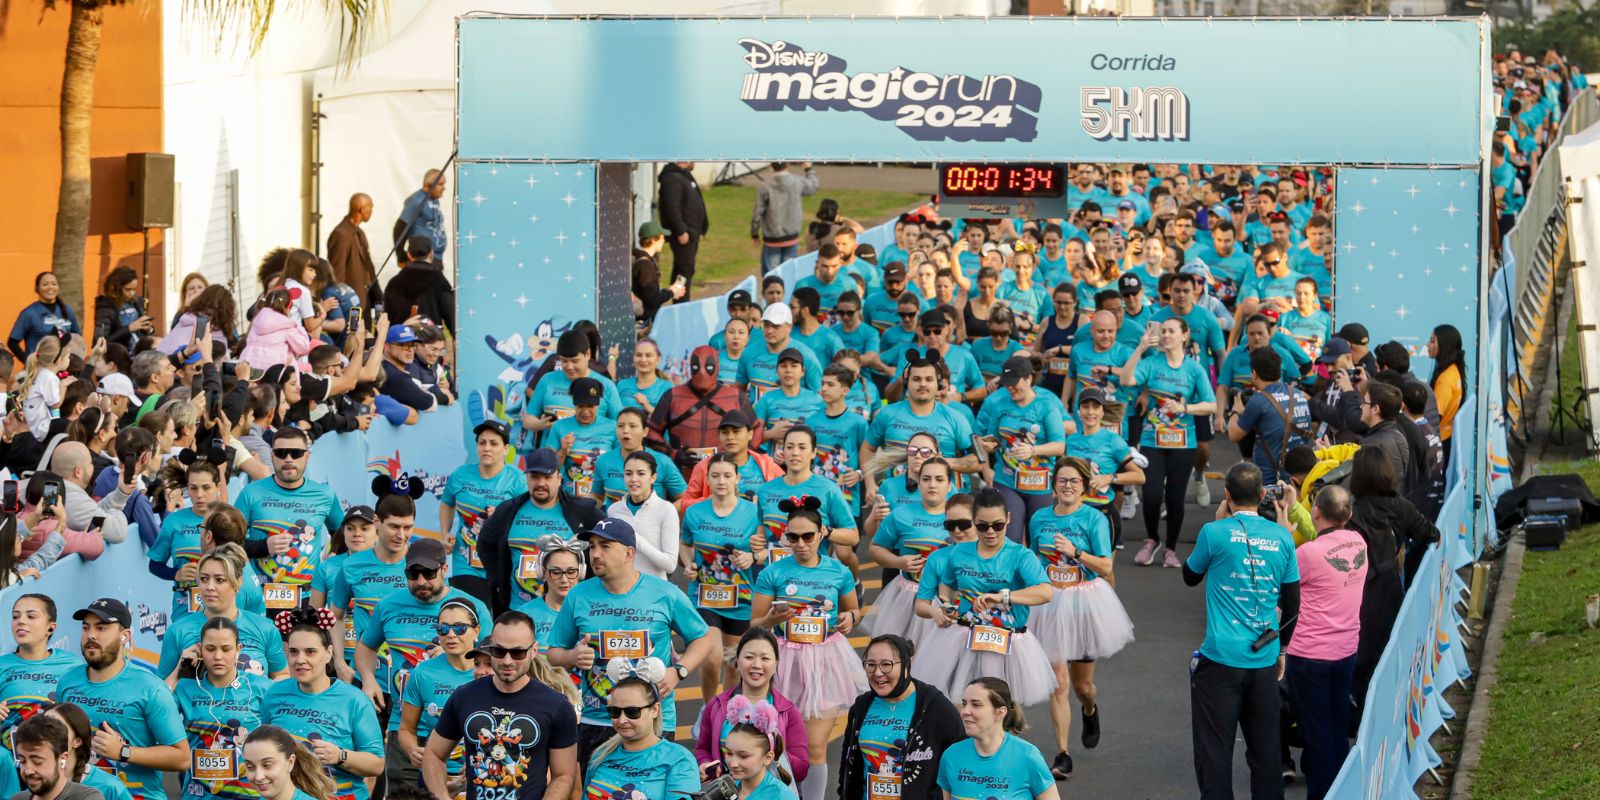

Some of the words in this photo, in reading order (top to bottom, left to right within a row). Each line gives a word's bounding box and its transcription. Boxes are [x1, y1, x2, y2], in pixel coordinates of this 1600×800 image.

[737, 38, 829, 76] Disney
[1090, 53, 1176, 71] Corrida
[896, 104, 1012, 128] 2024
[1080, 86, 1190, 141] 5KM
[268, 589, 292, 599] 7185
[706, 590, 730, 599] 6982
[793, 623, 819, 633] 7419
[345, 629, 357, 639] 68
[977, 631, 1004, 645] 7398
[609, 638, 638, 648] 6732
[96, 706, 125, 715] 2024
[491, 707, 516, 717] Disney
[307, 717, 337, 728] 2024
[198, 756, 227, 768] 8055
[903, 764, 923, 785] COAST
[476, 786, 517, 800] 2024
[873, 783, 899, 794] 6551
